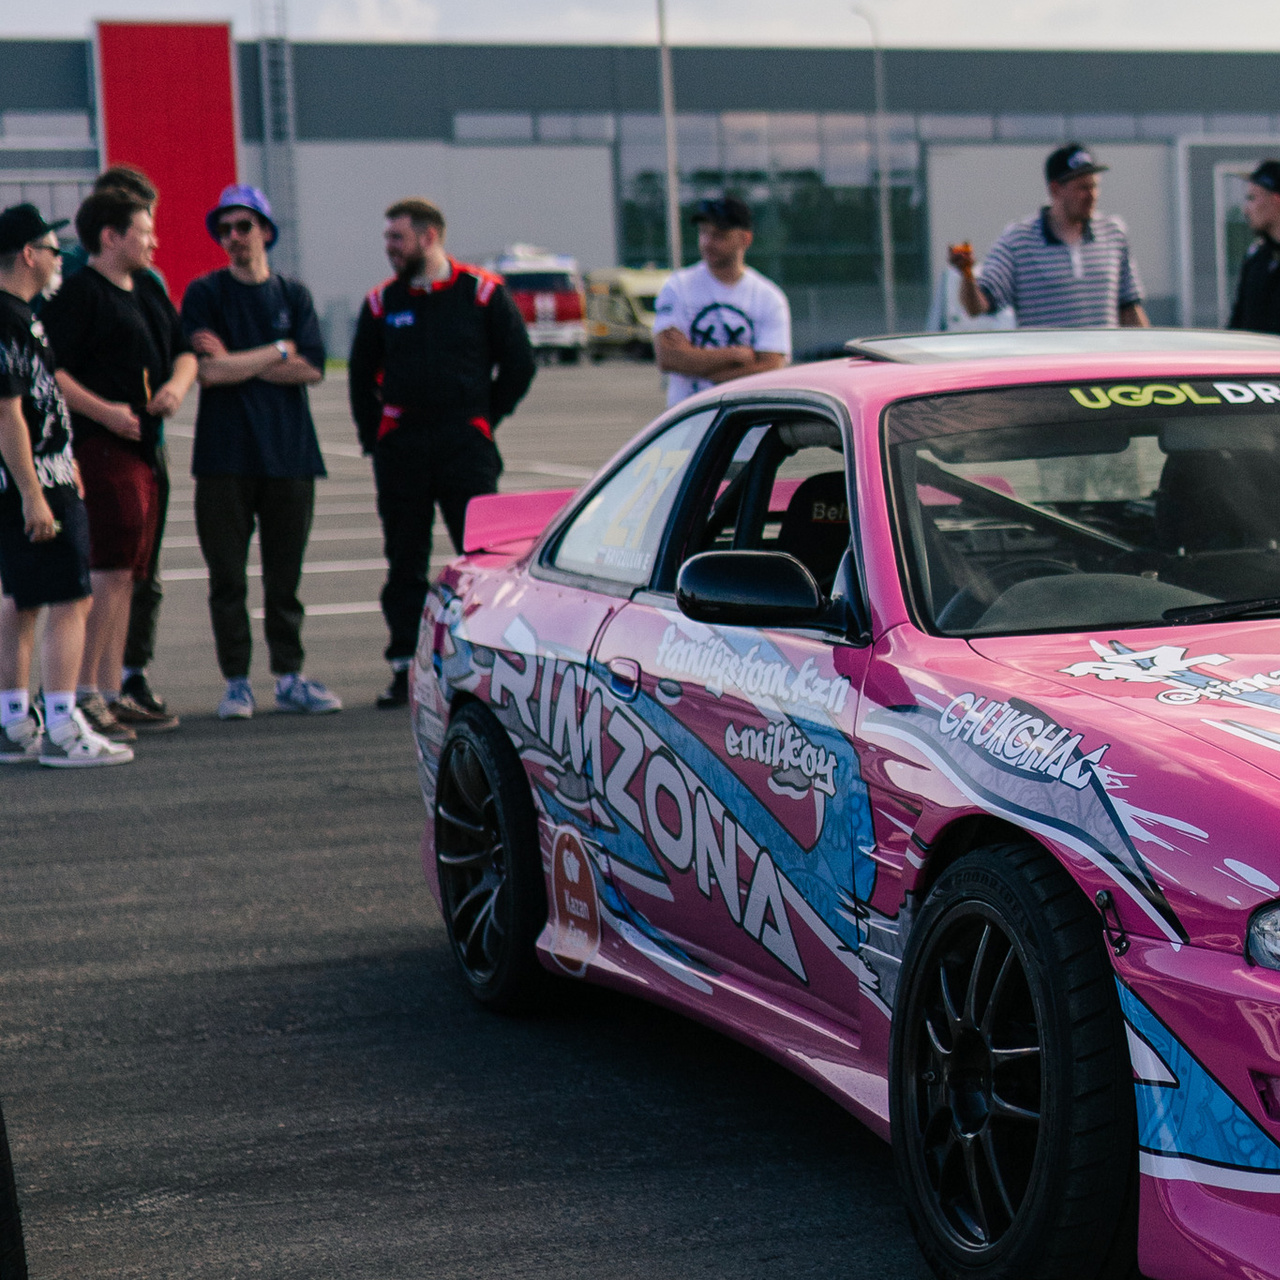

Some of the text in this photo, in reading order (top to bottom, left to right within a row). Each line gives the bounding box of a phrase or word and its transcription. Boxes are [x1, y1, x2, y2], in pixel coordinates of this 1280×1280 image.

[602, 447, 691, 550] 27
[490, 616, 808, 984] RIMZONA
[724, 721, 838, 798] emilkoy
[564, 889, 589, 920] Kazan
